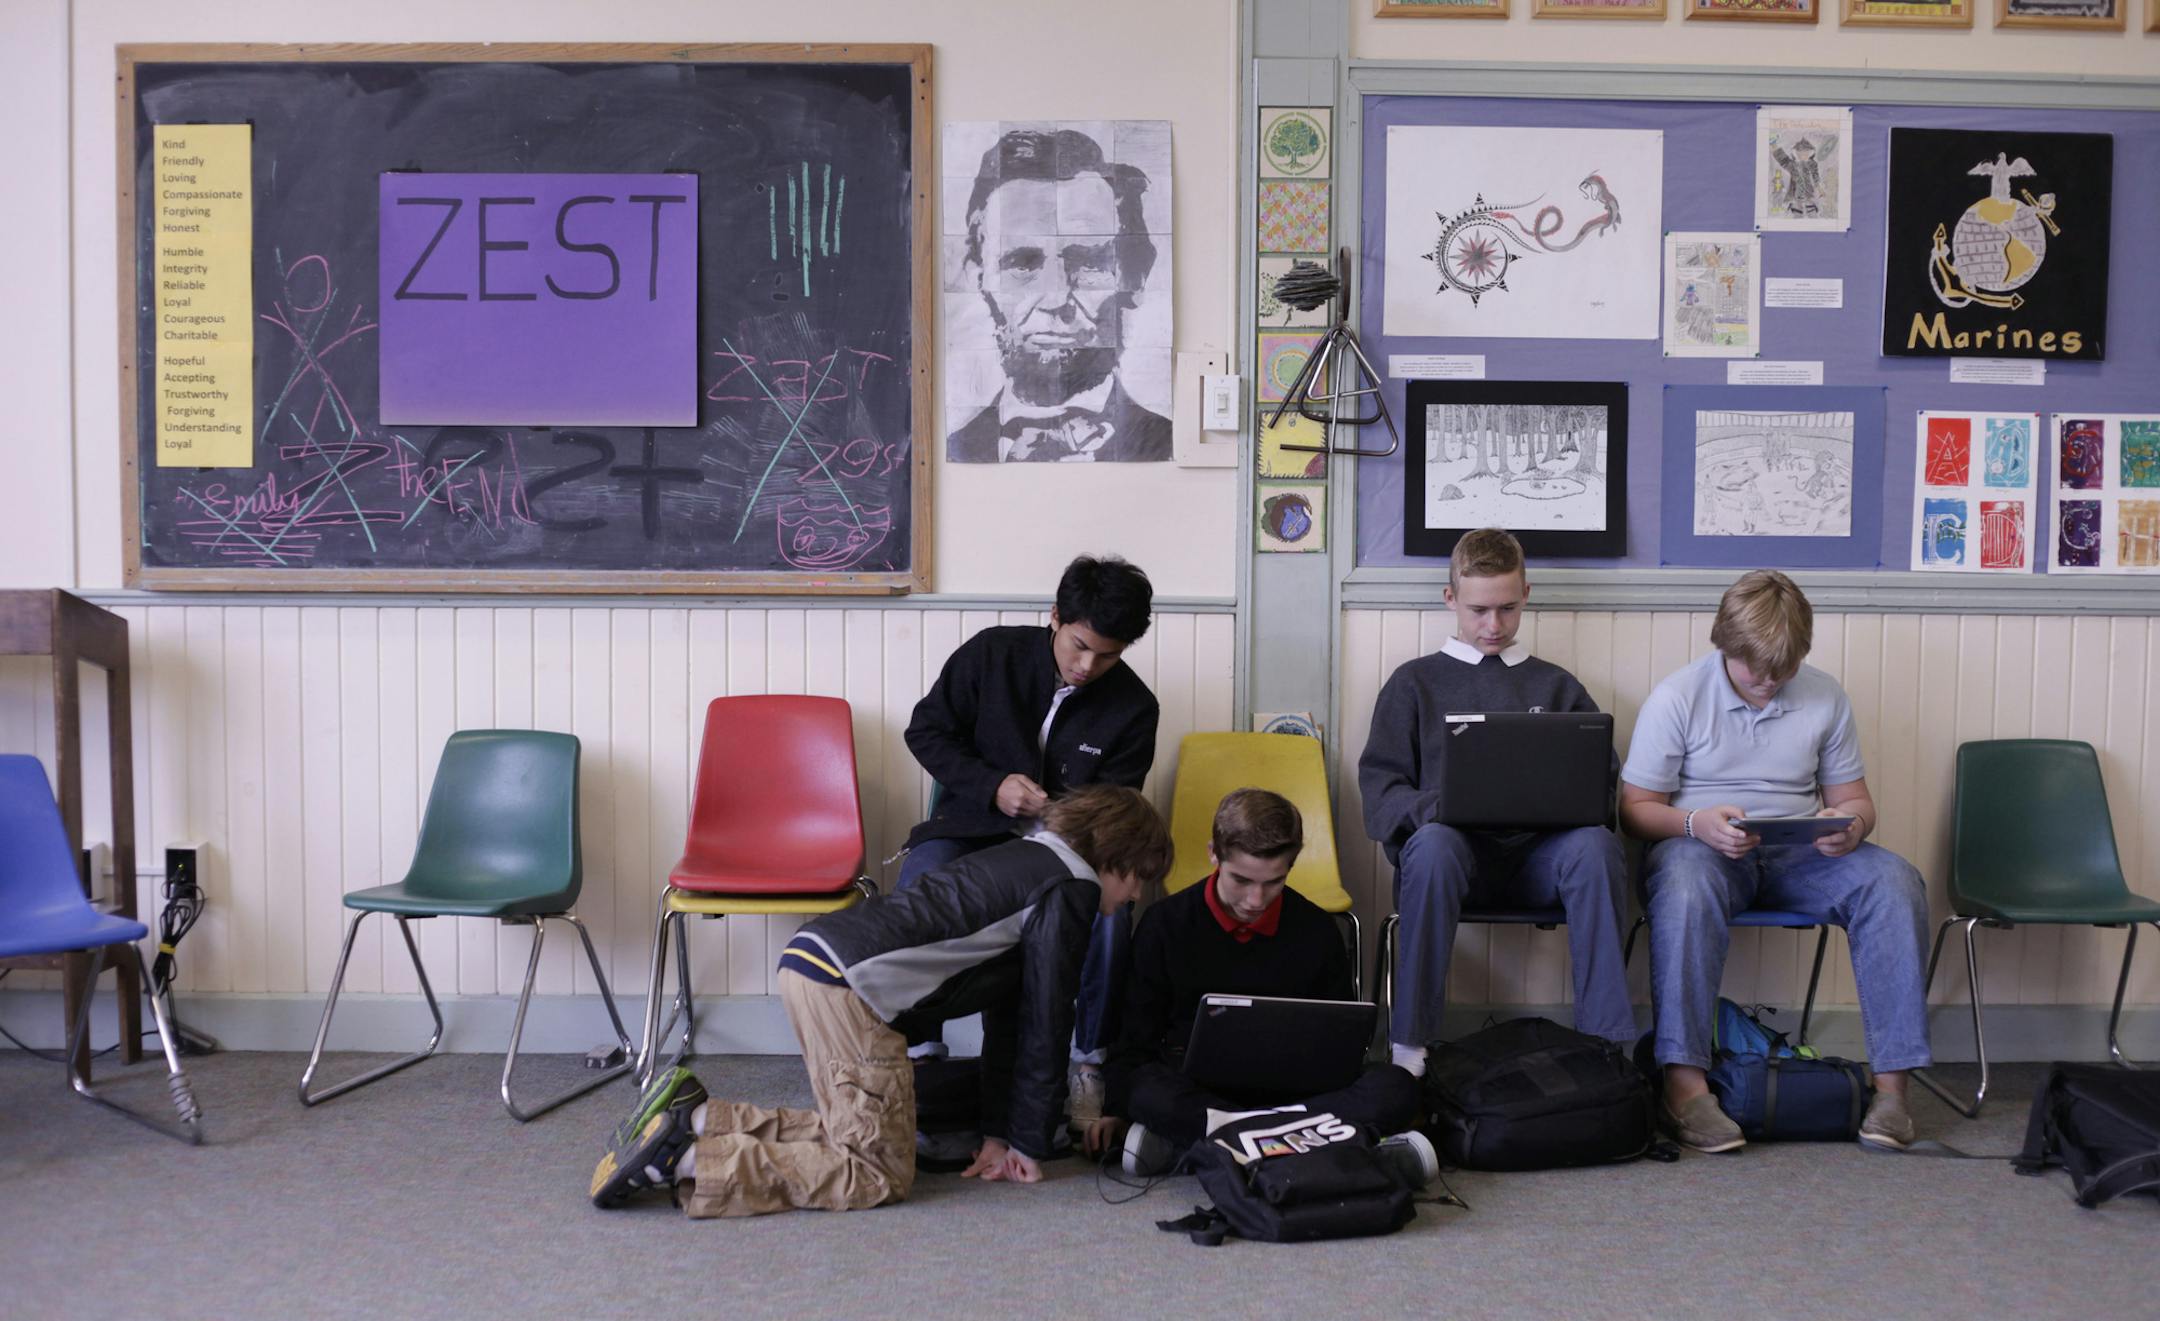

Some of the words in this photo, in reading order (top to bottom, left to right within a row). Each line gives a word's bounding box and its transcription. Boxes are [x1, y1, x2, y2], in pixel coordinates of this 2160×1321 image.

[162, 140, 186, 149] Kind
[162, 157, 205, 167] Friendly
[162, 174, 197, 184] Loving
[163, 190, 243, 201] Compassionate
[163, 207, 211, 218] Forgiving
[163, 224, 200, 233] Honest
[163, 248, 204, 257] Humble
[394, 194, 688, 303] ZEST
[163, 265, 208, 275] Integrity
[163, 281, 206, 290] Reliable
[163, 298, 191, 308] Loyal
[165, 314, 226, 326] Courageous
[165, 331, 218, 340] Charitable
[1907, 311, 2083, 355] Marines
[164, 356, 206, 366] Hopeful
[164, 373, 216, 384] Accepting
[164, 390, 229, 401] Trustworthy
[167, 406, 216, 417] Forgiving
[165, 423, 242, 435] Understanding
[165, 440, 192, 450] Loyal
